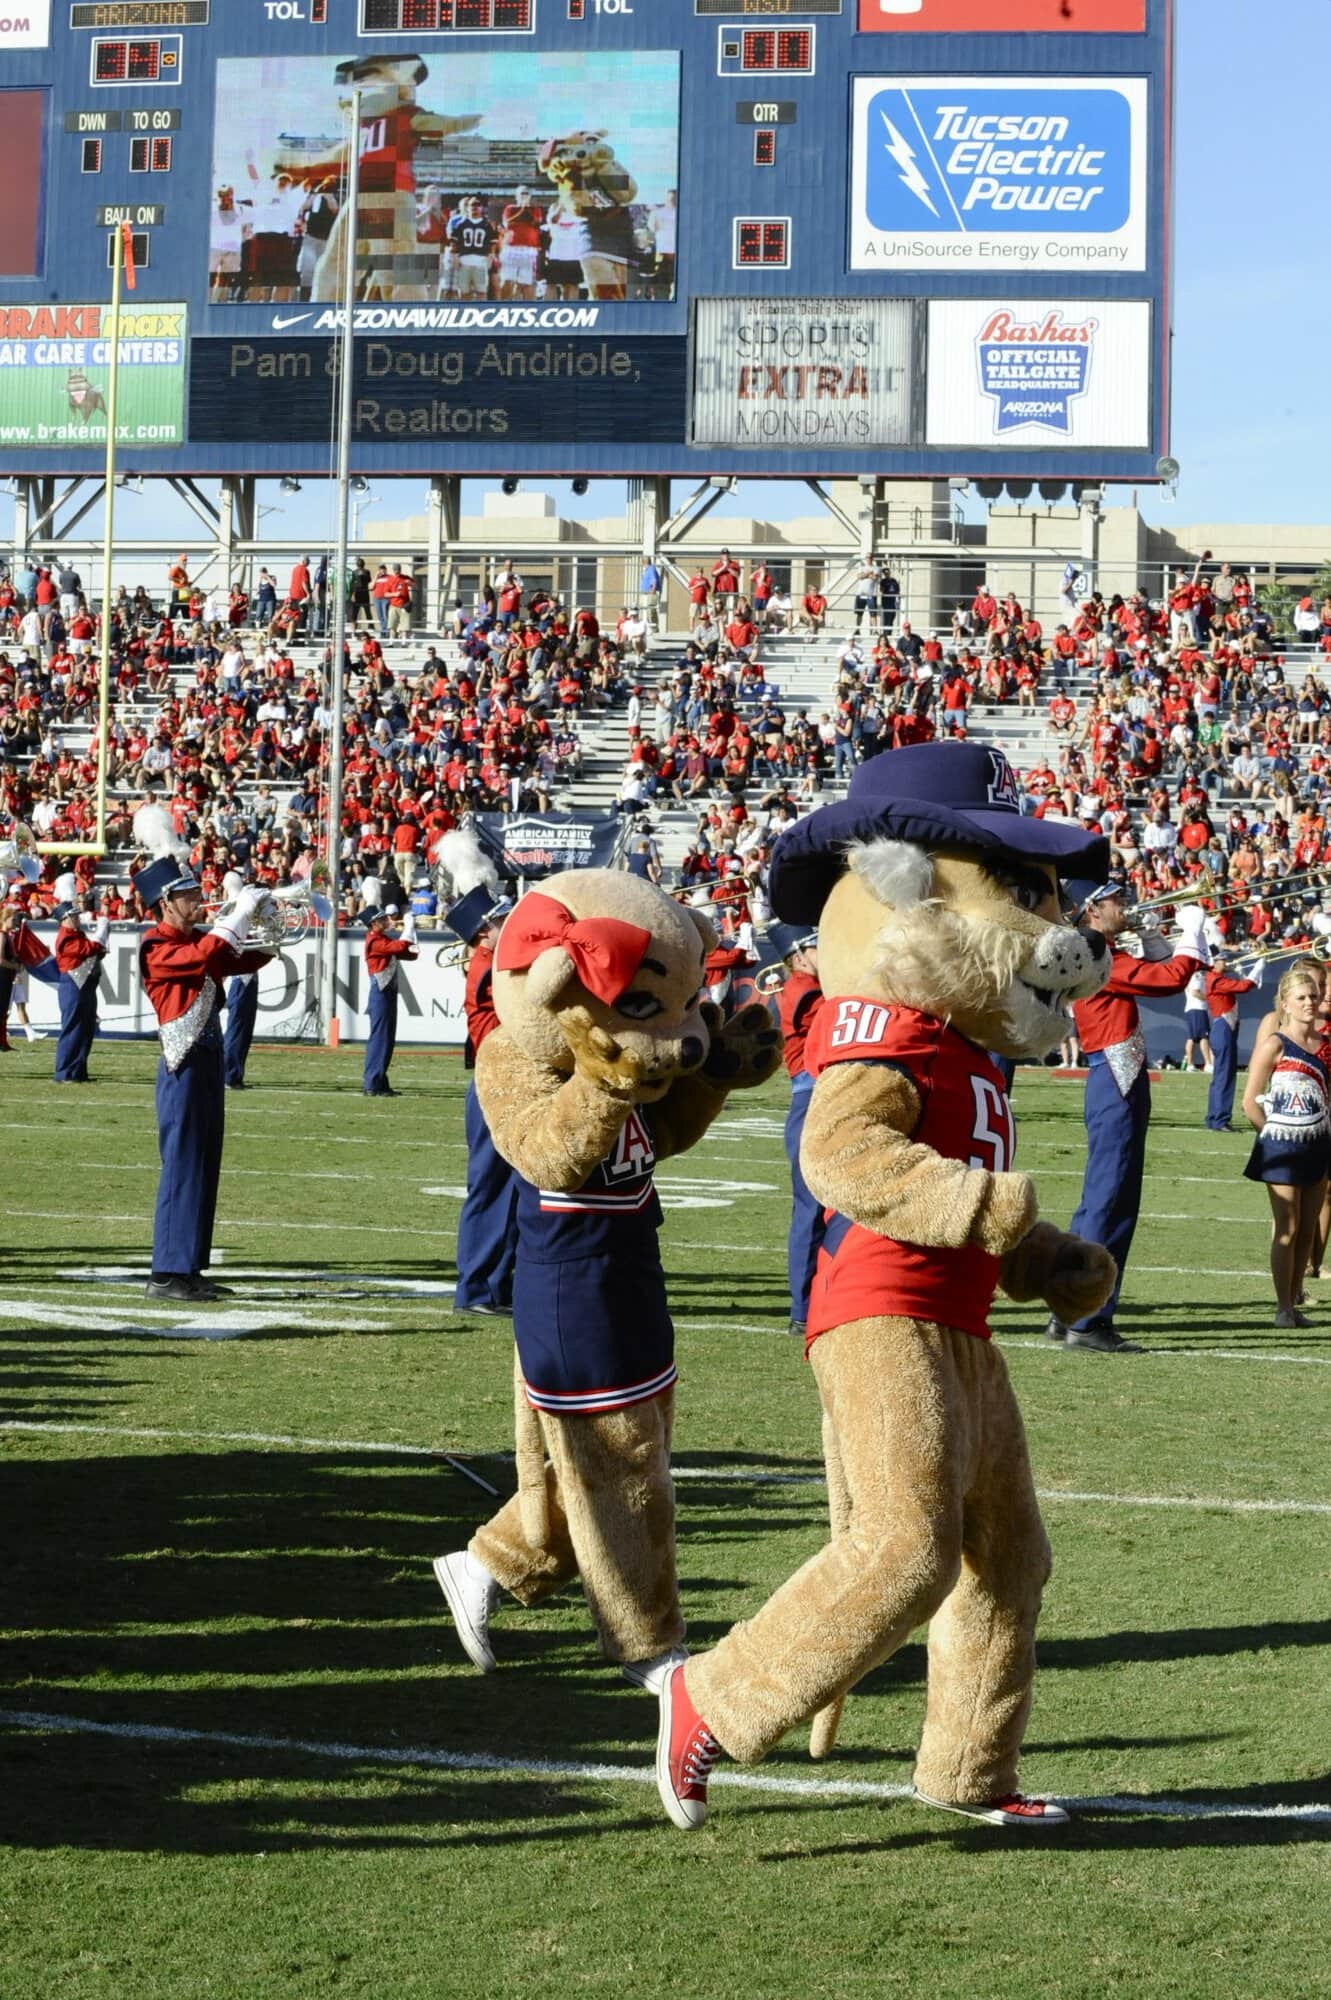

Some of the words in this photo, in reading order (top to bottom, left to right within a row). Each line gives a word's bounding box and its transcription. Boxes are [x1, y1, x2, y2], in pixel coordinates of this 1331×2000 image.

[94, 4, 187, 26] ARIZONA
[264, 2, 305, 19] TOL
[593, 0, 634, 14] TOL
[96, 42, 159, 78] 34
[744, 31, 809, 68] 00
[79, 113, 106, 131] DWN
[133, 112, 149, 129] TO
[153, 111, 171, 129] GO
[753, 103, 778, 122] QTR
[933, 106, 1069, 141] Tucson
[143, 138, 170, 170] 10
[755, 132, 773, 163] 3
[946, 143, 1105, 175] Electric
[961, 177, 1104, 211] Power
[104, 207, 133, 225] BALL
[137, 207, 155, 224] ON
[463, 228, 486, 247] 00
[740, 225, 784, 261] 25
[864, 242, 876, 257] A
[883, 241, 972, 257] UniSource
[979, 242, 1040, 260] Energy
[1045, 242, 1128, 261] Company
[103, 314, 184, 338] max
[313, 307, 599, 329] ARZONAWILDCATS.COM
[980, 313, 1094, 342] Bashas'
[34, 343, 85, 365] CARE
[736, 326, 870, 358] SPORTS
[230, 345, 311, 377] Pam
[367, 343, 464, 384] Doug
[475, 343, 641, 384] Andriole,
[987, 349, 1081, 363] OFFICIAL
[737, 365, 869, 399] EXTRA
[986, 366, 1080, 379] TAILGATE
[987, 380, 1080, 391] HEADQUARTERS
[355, 399, 510, 433] Realtors
[1002, 401, 1063, 413] ARIZONA
[737, 409, 871, 436] MONDAYS
[505, 829, 554, 838] AMERICAN
[557, 829, 592, 838] FAMILY
[832, 1000, 891, 1047] 50
[1282, 1090, 1312, 1116] A
[605, 1106, 655, 1181] A
